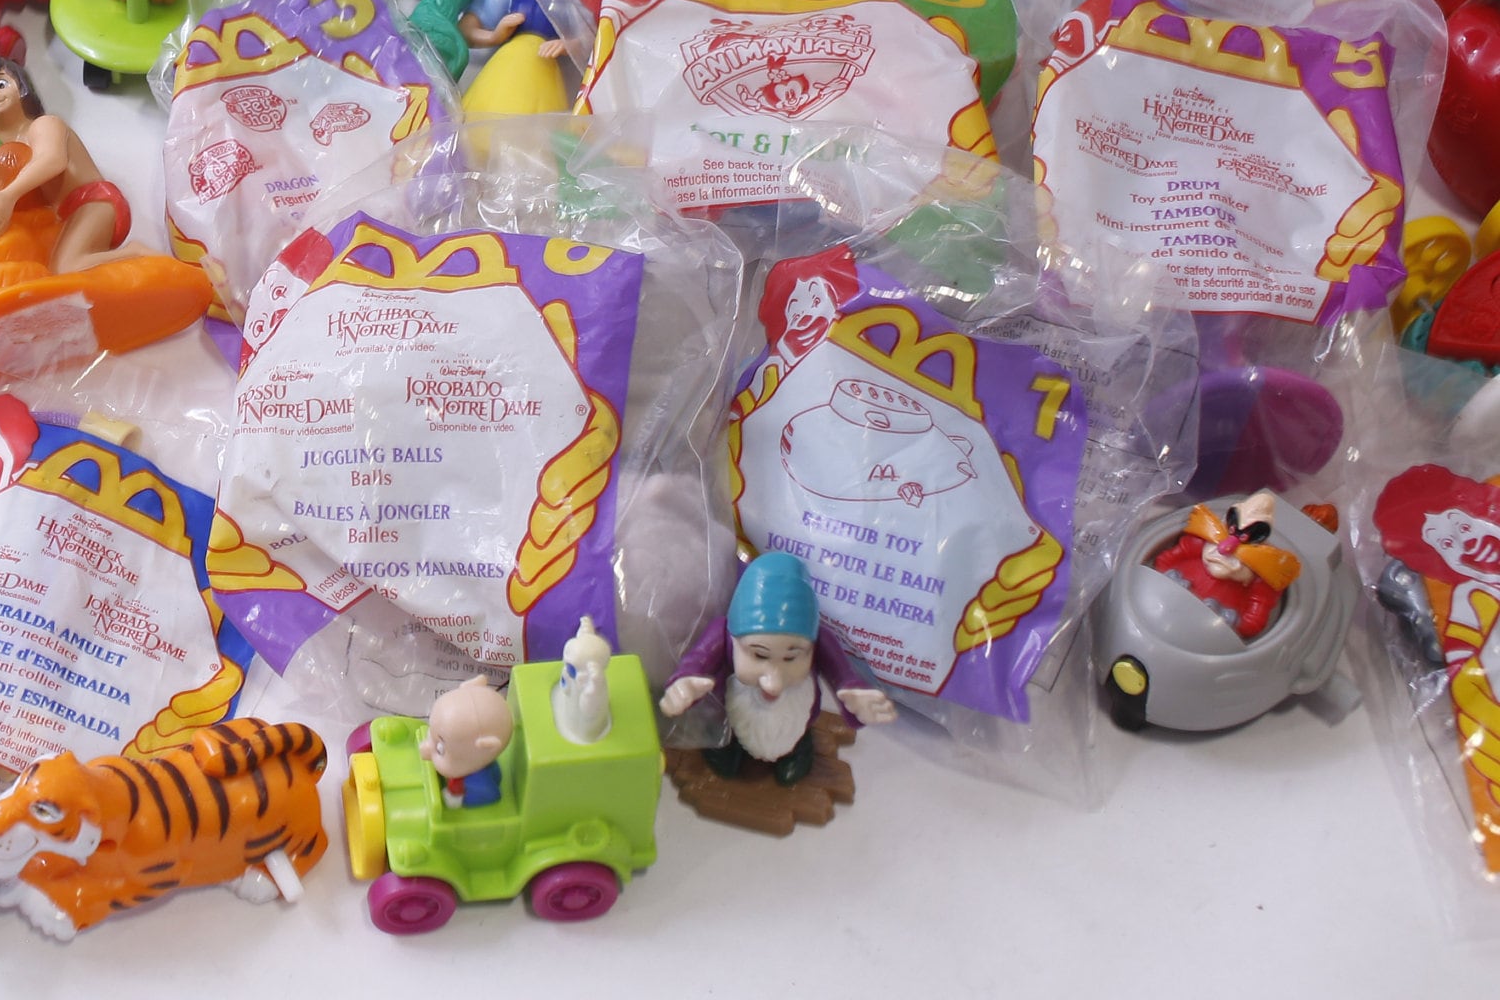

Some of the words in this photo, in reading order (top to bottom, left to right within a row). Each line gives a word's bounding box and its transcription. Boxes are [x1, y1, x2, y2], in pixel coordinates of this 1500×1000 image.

[691, 37, 864, 90] ANIMANIACS
[1330, 41, 1387, 89] 5
[1142, 98, 1235, 130] HUNCHBACK
[703, 159, 724, 171] See
[728, 160, 754, 170] back
[264, 175, 320, 193] DRAGON
[712, 185, 780, 199] información
[1167, 181, 1220, 191] DRUM
[1129, 193, 1155, 205] Toy
[1160, 192, 1203, 203] sound
[1209, 192, 1250, 213] maker
[1151, 205, 1237, 225] TAMBOUR
[1095, 212, 1209, 232] Mini-instrument
[1160, 234, 1238, 248] TAMBOR
[1179, 248, 1228, 259] sonido
[1188, 289, 1218, 300] sobre
[1220, 290, 1272, 303] seguridad
[327, 308, 437, 338] HUNCHBACK
[341, 323, 400, 348] NOTRE
[401, 318, 459, 340] DAME
[405, 376, 502, 404] JOROBADO
[241, 400, 305, 425] NOTRE
[304, 397, 356, 424] DAME
[426, 397, 489, 423] NOTRE
[487, 397, 542, 423] DAME
[1029, 374, 1071, 441] 7
[296, 423, 355, 437] vidéocassette!
[429, 422, 477, 433] Disponible
[493, 422, 516, 433] video.
[301, 448, 386, 469] JUGGLING
[391, 447, 444, 465] BALLS
[350, 469, 393, 488] Balls
[293, 502, 353, 522] BALLES
[359, 501, 370, 521] À
[376, 504, 450, 524] JONGLER
[35, 515, 124, 567] HUNCHBACK
[348, 526, 399, 544] Balles
[885, 533, 923, 557] TOY
[47, 534, 99, 569] NOTRE
[97, 550, 139, 586] DAME
[343, 561, 410, 578] JUEGOS
[416, 561, 505, 579] MALABARES
[765, 532, 815, 559] JOUET
[818, 548, 868, 576] POUR
[873, 563, 896, 582] LE
[899, 570, 945, 596] BAIN
[3, 572, 49, 596] DAME
[84, 594, 159, 634] JOROBADO
[835, 583, 859, 606] DE
[863, 593, 935, 626] BAÑERA
[21, 628, 79, 663] necklace
[58, 627, 128, 668] AMULET
[95, 615, 145, 646] NOTRE
[143, 632, 188, 662] DAME
[16, 648, 131, 706] d'ESMERALDA
[12, 707, 67, 734] juguete
[20, 688, 121, 741] ESMERALDA
